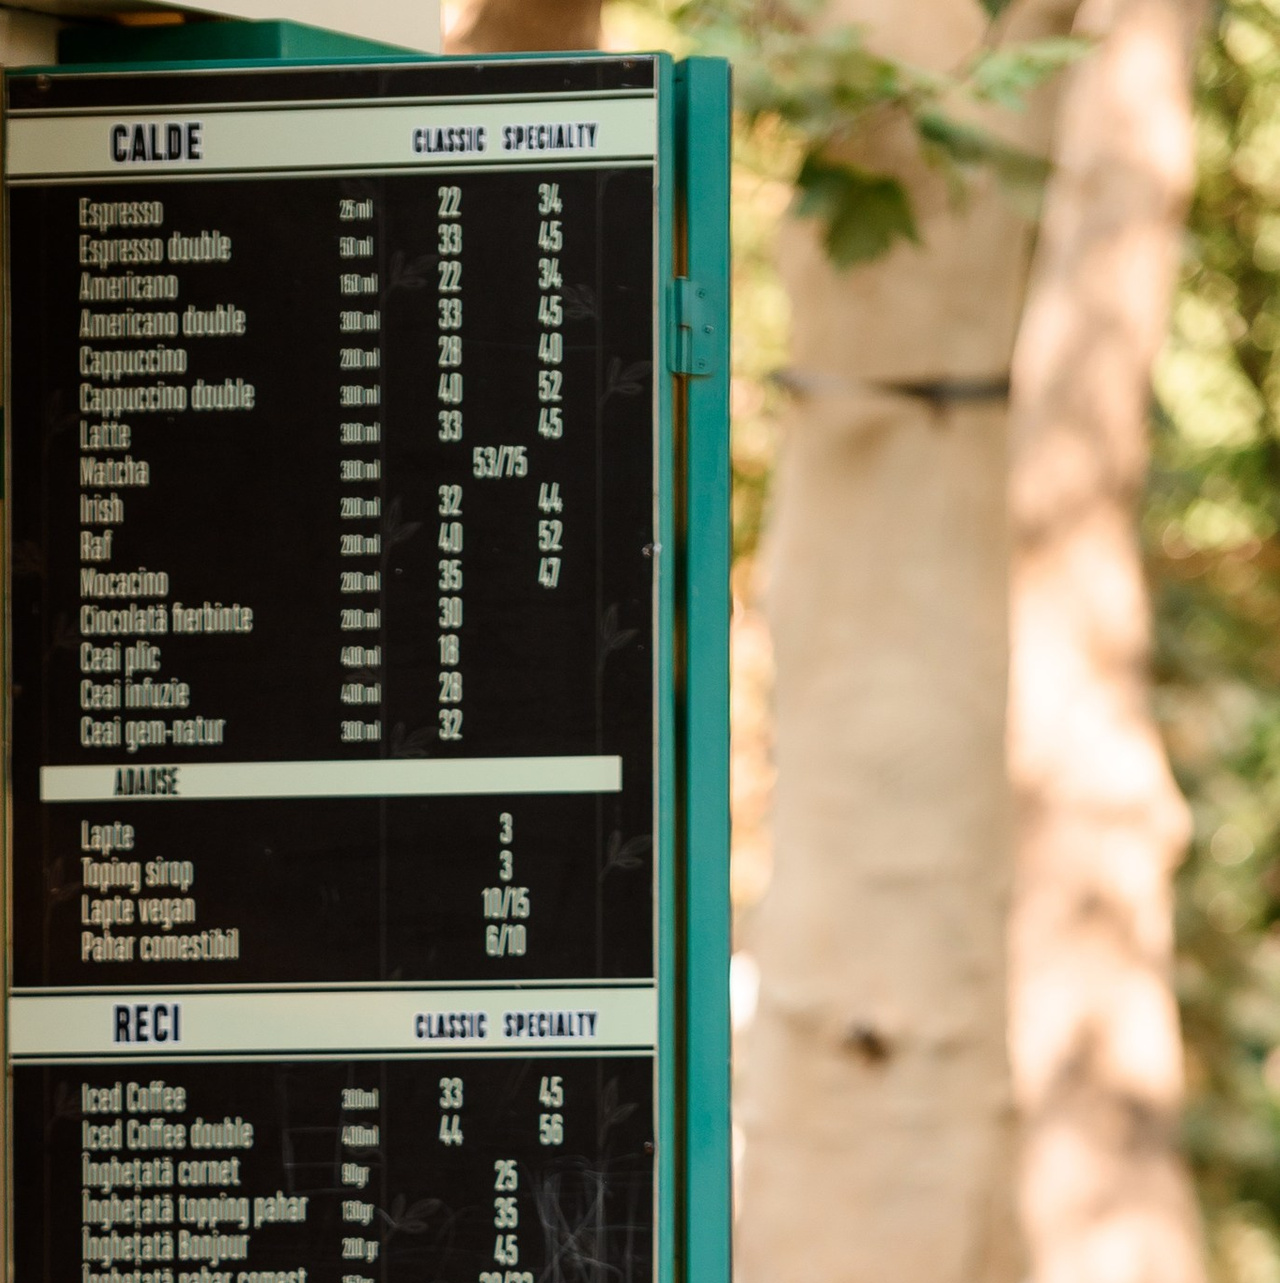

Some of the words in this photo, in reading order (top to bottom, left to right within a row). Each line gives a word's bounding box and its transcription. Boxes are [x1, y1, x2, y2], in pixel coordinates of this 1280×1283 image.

[111, 122, 203, 163] CALDE
[413, 126, 487, 153] CLASSIC
[503, 122, 598, 151] SPECIALTY
[80, 198, 163, 231] Espresso
[438, 187, 461, 217] 22
[539, 183, 562, 214] 34
[80, 235, 163, 272] Espresso
[168, 231, 231, 261] double
[438, 224, 462, 254] 33
[538, 221, 562, 251] 45
[80, 272, 178, 299] Americano
[439, 261, 461, 292] 22
[539, 258, 562, 289] 34
[80, 309, 178, 337] Americano
[183, 305, 245, 335] double
[439, 298, 462, 328] 33
[538, 296, 562, 326] 45
[80, 345, 187, 383] Cappuccino
[439, 336, 461, 366] 28
[538, 333, 562, 363] 40
[80, 380, 187, 417] Cappuccino
[192, 378, 254, 409] double
[438, 373, 462, 403] 40
[539, 370, 562, 401] 52
[80, 421, 130, 449] Latte
[439, 410, 462, 441] 33
[538, 408, 562, 438] 45
[81, 456, 149, 486] Matcha
[473, 445, 527, 477] 53/75
[81, 493, 123, 523] Irish
[439, 485, 462, 515] 32
[539, 483, 563, 512] 44
[439, 522, 462, 552] 40
[539, 520, 562, 551] 52
[439, 560, 462, 590] 35
[539, 557, 560, 587] 47
[439, 597, 462, 627] 30
[81, 642, 120, 671] Ceai
[126, 641, 160, 677] plic
[439, 634, 459, 665] 18
[81, 679, 120, 709] Ceai
[439, 672, 462, 702] 28
[81, 716, 121, 746] Ceai
[439, 709, 462, 739] 32
[82, 821, 134, 857] Lapte
[500, 813, 512, 843] 3
[82, 857, 140, 895] Toping
[146, 856, 193, 891] sirop
[500, 850, 512, 880] 3
[82, 893, 134, 931] Lapte
[139, 898, 195, 930] vegan
[482, 886, 529, 918] 10/15
[82, 930, 135, 961] Pahar
[486, 924, 526, 956] 6/10
[114, 1004, 181, 1042] RECI
[416, 1012, 487, 1039] CLASSIC
[504, 1011, 598, 1038] SPECIALTY
[82, 1082, 122, 1113] Iced
[127, 1081, 185, 1112] Coffee
[440, 1078, 463, 1108] 33
[539, 1076, 563, 1107] 45
[83, 1119, 122, 1149] Iced
[127, 1118, 186, 1149] Coffee
[191, 1117, 253, 1148] double
[439, 1115, 463, 1144] 44
[540, 1114, 563, 1144] 56
[178, 1157, 240, 1185] cornet
[495, 1160, 517, 1190] 25
[179, 1193, 249, 1230] topping
[254, 1191, 308, 1227] pahar
[495, 1197, 517, 1228] 35
[179, 1229, 249, 1268] Bonjour
[494, 1235, 518, 1265] 45
